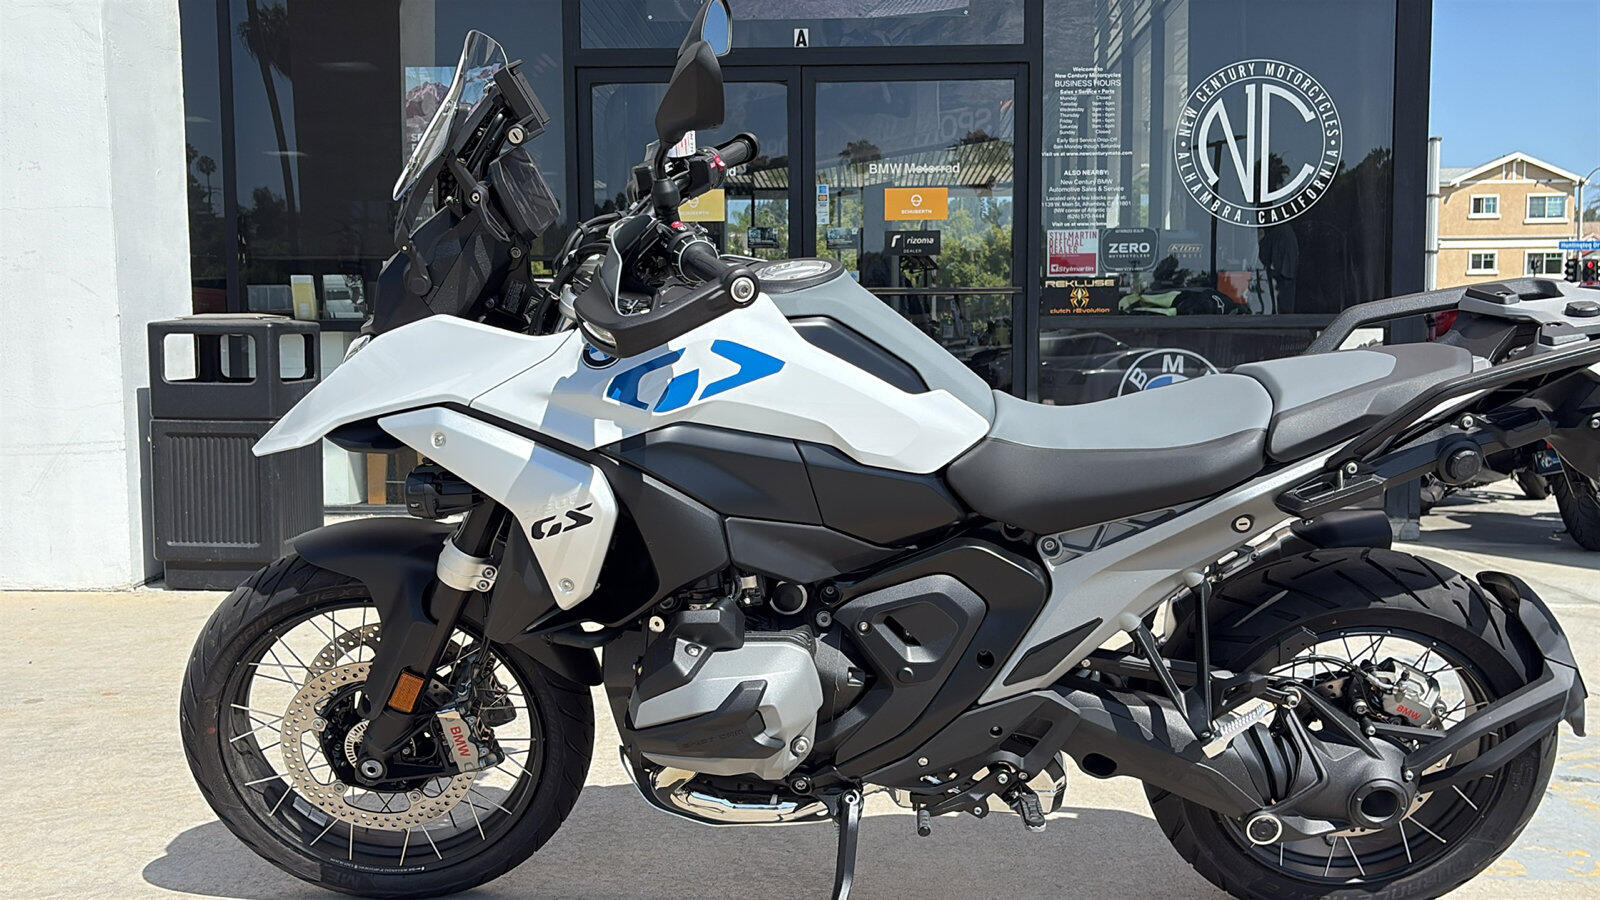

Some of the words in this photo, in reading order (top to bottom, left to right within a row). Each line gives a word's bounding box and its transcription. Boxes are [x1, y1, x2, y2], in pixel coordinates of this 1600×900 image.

[795, 29, 808, 47] A
[1054, 80, 1093, 88] BUSINESS
[1094, 79, 1122, 87] HOURS
[1178, 106, 1198, 138] NEW
[1195, 62, 1256, 103] CENTURY
[1264, 62, 1340, 138] MOTORCYCLES
[869, 163, 902, 174] BMW
[904, 162, 960, 174] Motorrad
[1074, 178, 1096, 186] Century
[1177, 151, 1250, 225] ALHAMBRA,
[1257, 149, 1339, 224] CALIFORNIA
[906, 235, 934, 245] rizoma
[1108, 242, 1150, 254] ZERO
[1057, 265, 1095, 273] Stylmartin
[1044, 279, 1115, 288] REKLUSE
[1395, 704, 1422, 720] BMW
[450, 726, 472, 757] BMW
